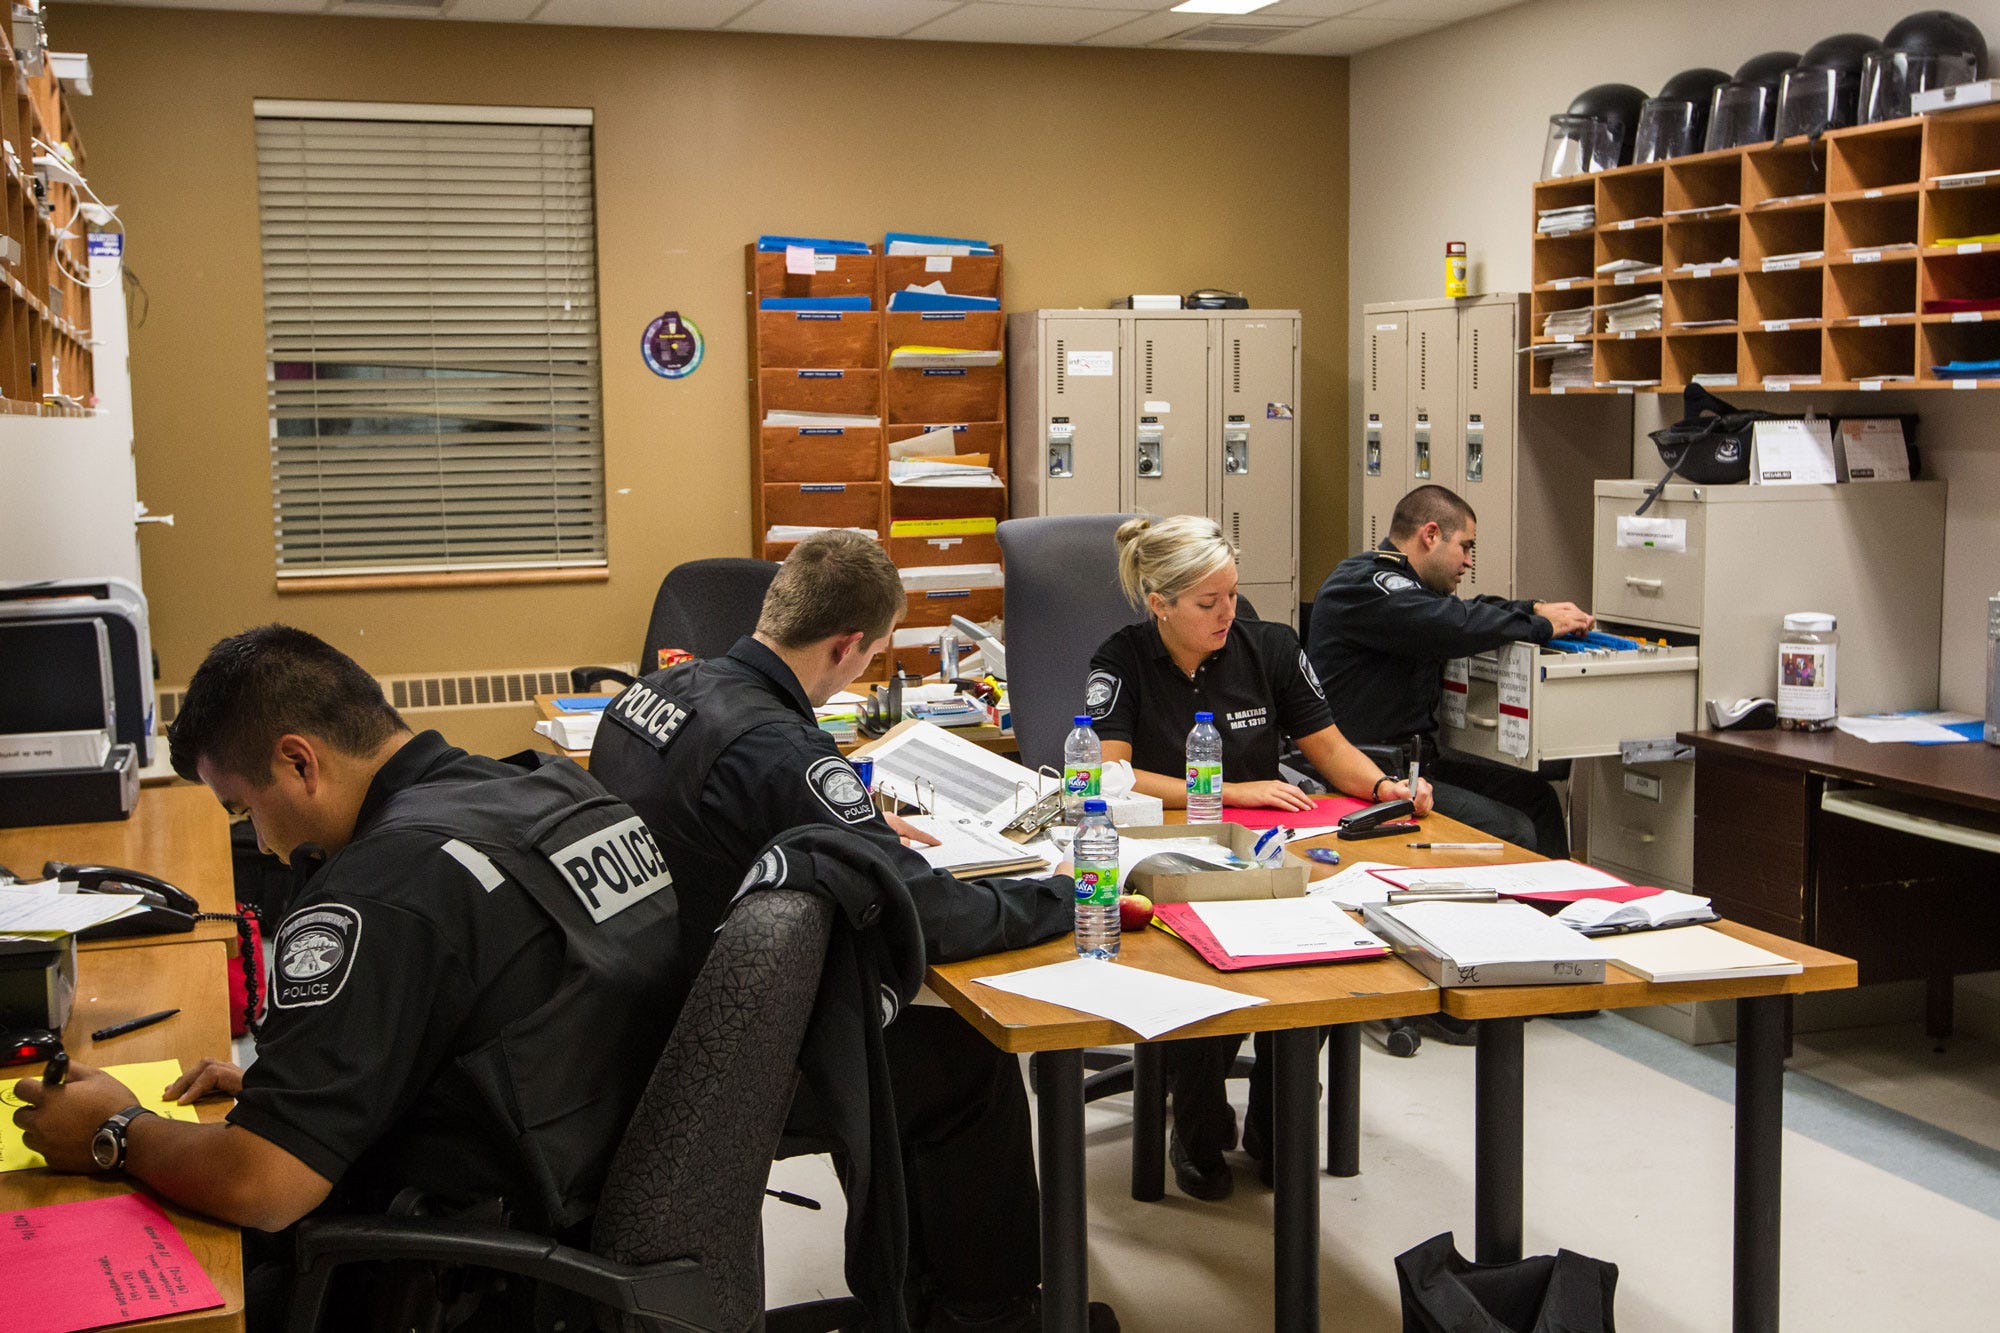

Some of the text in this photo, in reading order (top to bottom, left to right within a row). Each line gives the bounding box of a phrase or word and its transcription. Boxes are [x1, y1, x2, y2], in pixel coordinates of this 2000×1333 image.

[615, 682, 687, 743] POLICE
[1235, 707, 1267, 719] MALTAIS
[1231, 719, 1247, 729] MAT.
[844, 804, 871, 819] POLICE
[562, 825, 668, 910] POLICE
[281, 983, 329, 1000] POLICE
